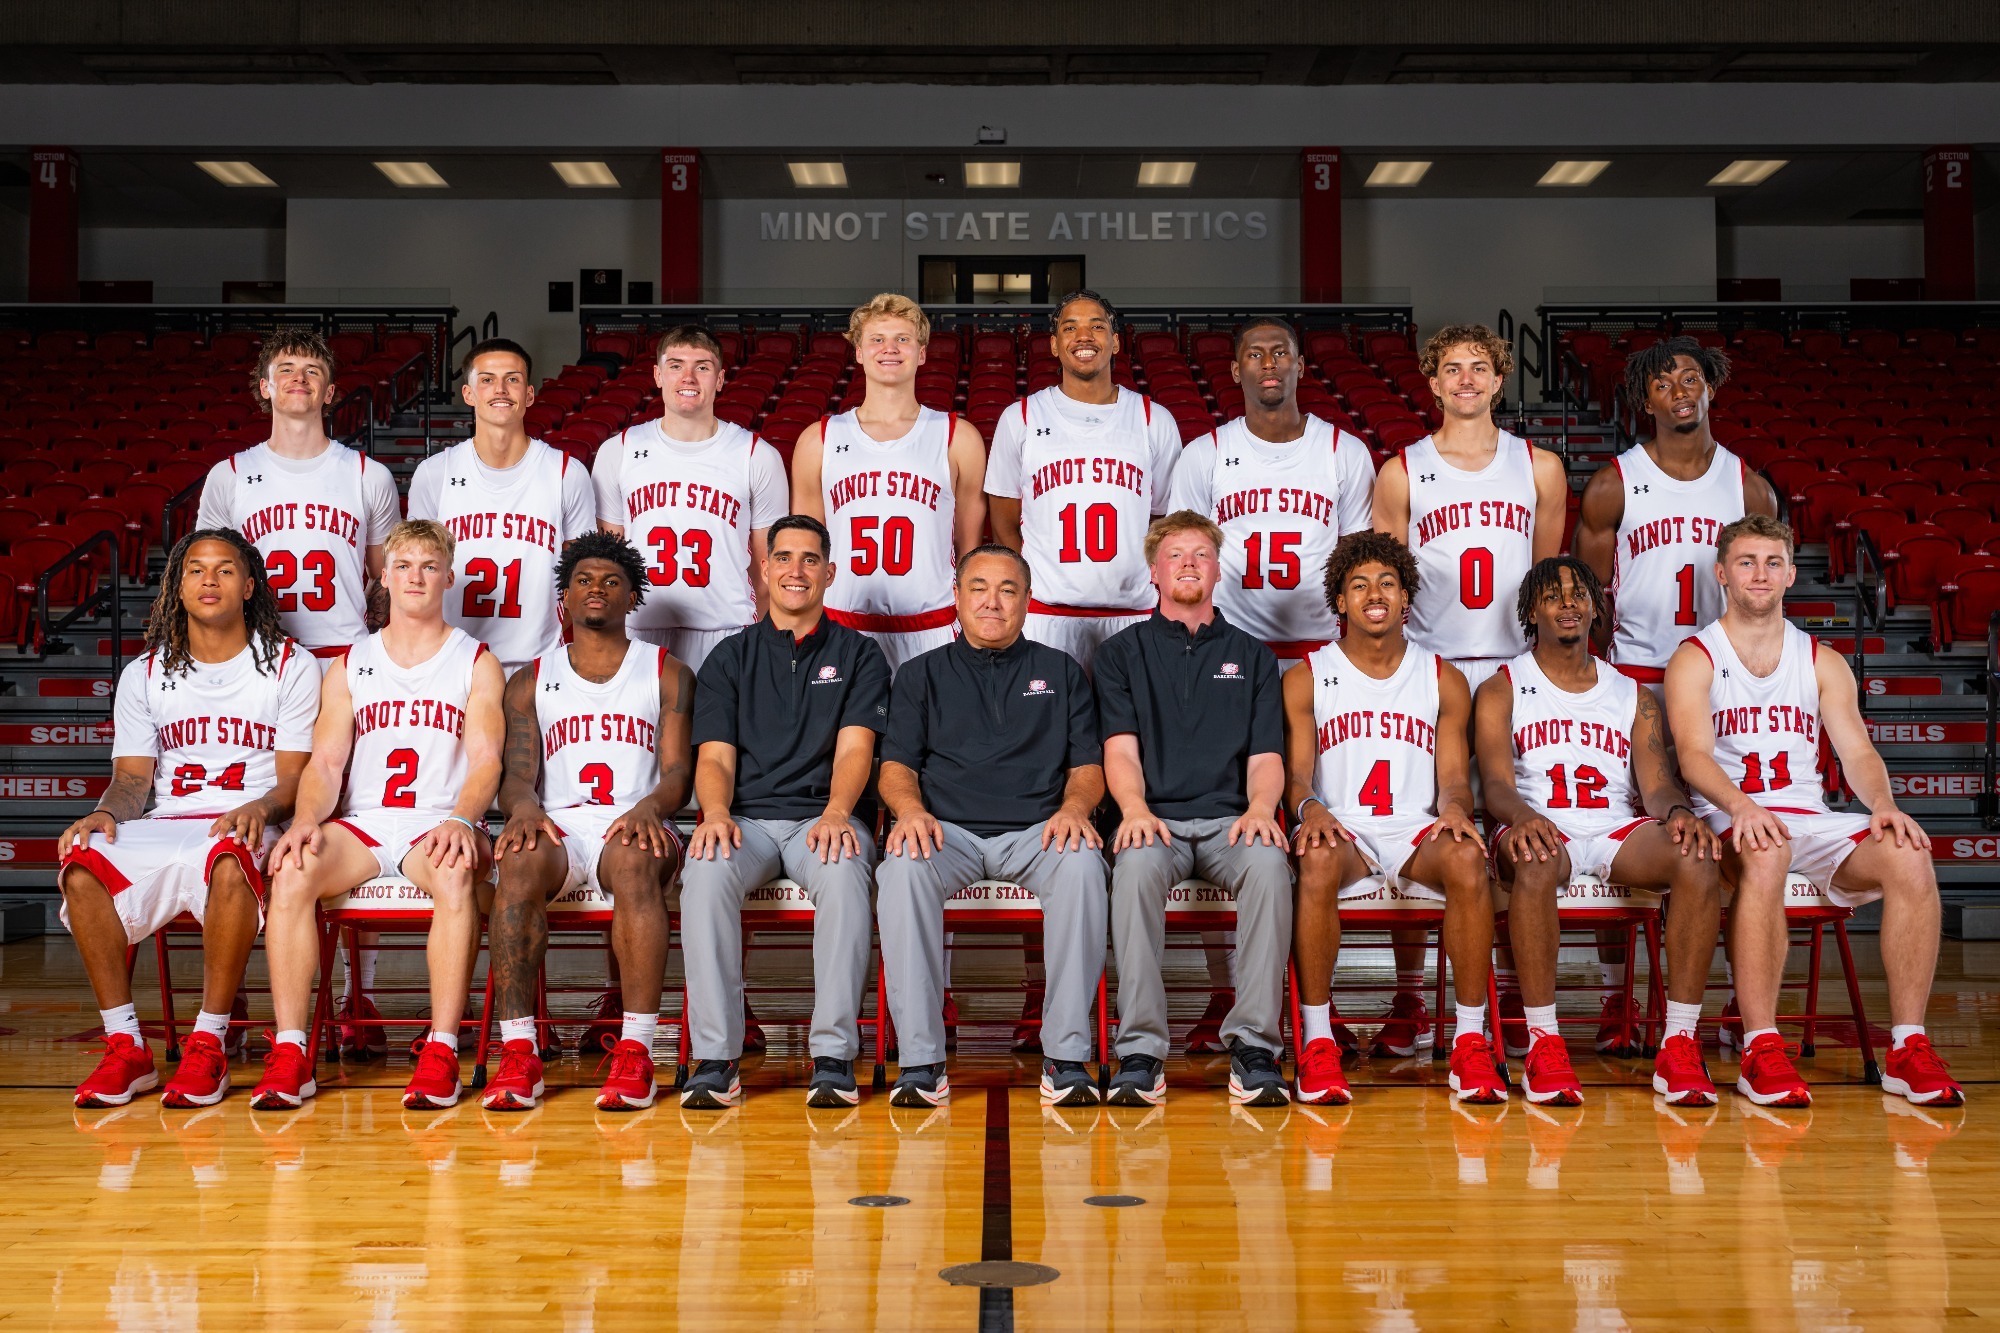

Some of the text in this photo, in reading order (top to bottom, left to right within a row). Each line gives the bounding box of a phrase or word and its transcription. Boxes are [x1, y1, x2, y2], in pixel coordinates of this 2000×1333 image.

[33, 152, 65, 161] SECTION
[39, 161, 58, 189] 4
[664, 155, 696, 163] SECTION
[1307, 154, 1338, 163] SECTION
[1938, 152, 1970, 161] SECTION
[1946, 161, 1962, 188] 2
[671, 164, 688, 191] 3
[1314, 164, 1331, 191] 3
[760, 211, 1268, 241] MINOT STATE ATHLETICS
[829, 471, 942, 514] MINOT STATE
[1032, 457, 1144, 500] MINOT STATE
[241, 503, 360, 548] MINOT STATE
[626, 482, 741, 529] MINOT STATE
[1215, 488, 1334, 527] MINOT STATE
[1416, 501, 1532, 548] MINOT STATE
[503, 513, 557, 554] STATE
[850, 516, 915, 576] 50
[1058, 503, 1118, 563] 10
[1627, 517, 1685, 560] MINOT
[647, 526, 713, 588] 33
[1241, 532, 1302, 590] 15
[265, 550, 336, 612] 23
[461, 557, 522, 618] 21
[1459, 547, 1494, 610] 0
[1674, 563, 1698, 626] 1
[217, 716, 277, 751] STATE
[409, 700, 465, 741] STATE
[545, 714, 655, 761] MINOT STATE
[1318, 711, 1435, 756] MINOT STATE
[1513, 719, 1574, 760] MINOT
[0, 779, 87, 797] HEELS
[170, 761, 247, 797] 24
[381, 748, 420, 808] 2
[579, 763, 616, 805] 3
[1358, 760, 1394, 816] 4
[1545, 763, 1610, 808] 12
[1739, 751, 1793, 794] 11
[1891, 776, 2000, 795] SCHEE
[349, 886, 394, 899] MINOT
[556, 890, 594, 902] NOT
[748, 887, 793, 901] MINOT
[996, 887, 1035, 899] STATE
[1196, 889, 1235, 901] STATE
[1592, 884, 1632, 897] STATE
